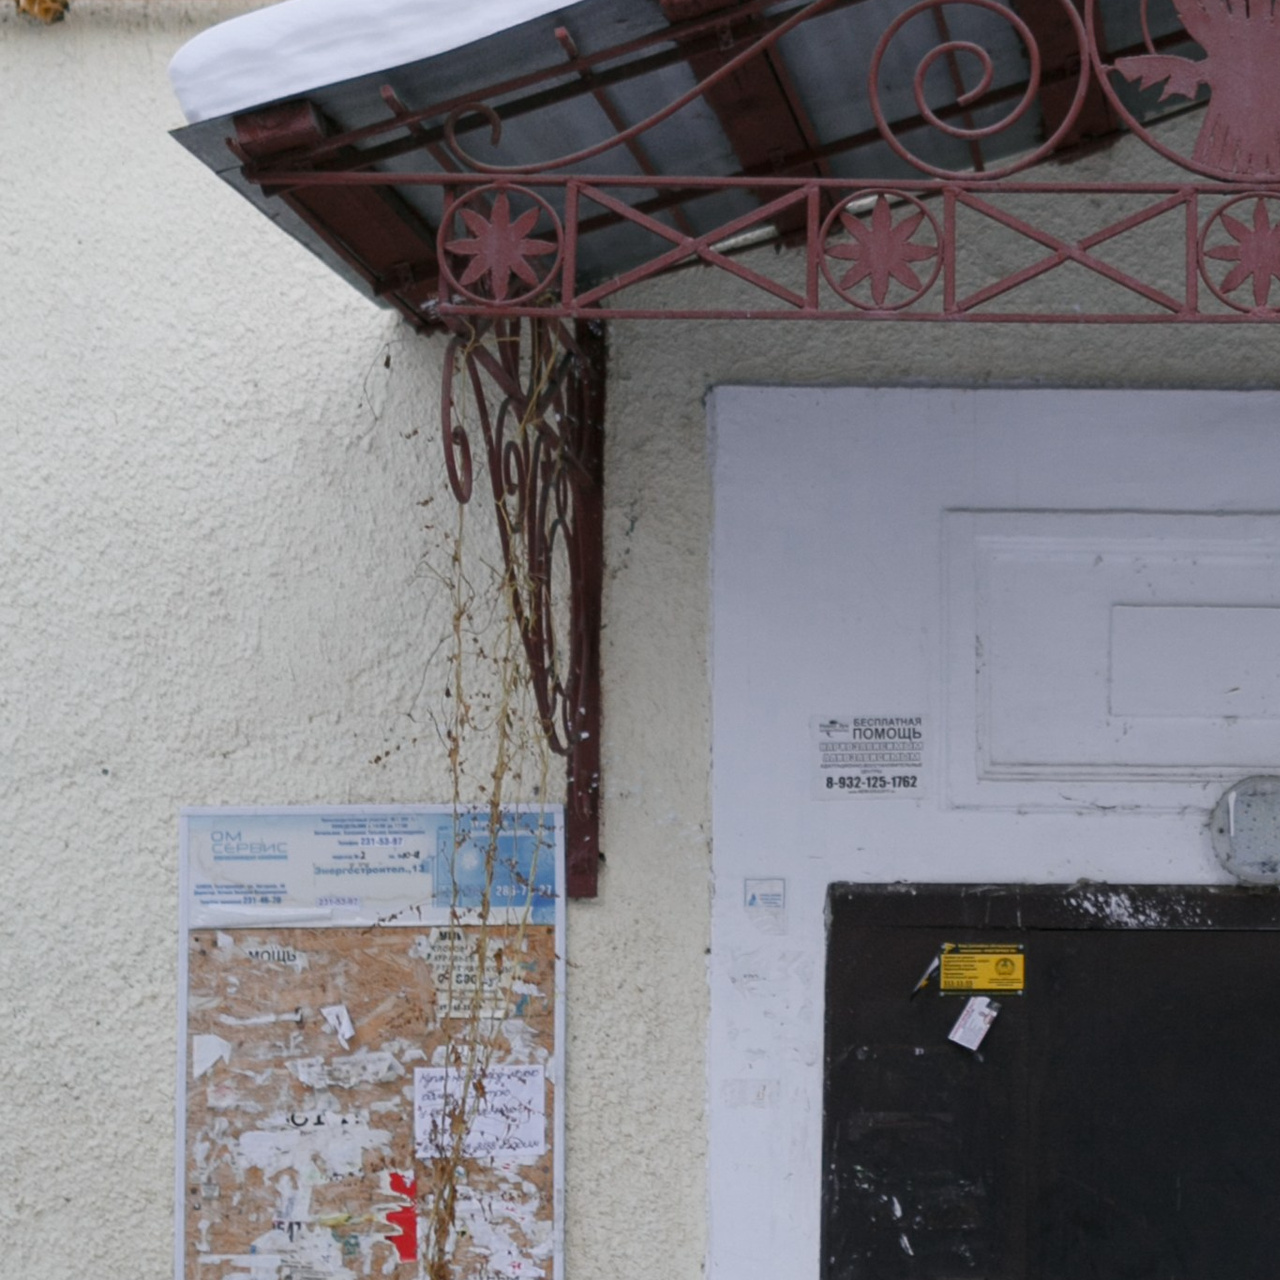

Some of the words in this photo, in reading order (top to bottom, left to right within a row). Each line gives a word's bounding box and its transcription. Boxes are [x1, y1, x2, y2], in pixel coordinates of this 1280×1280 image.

[853, 718, 922, 727] БЕСПЛАТНАЯ
[852, 727, 922, 741] ПОМОЩЬ
[826, 776, 917, 789] 8-932-125-1762
[211, 831, 242, 841] ОМ
[211, 842, 288, 854] СЕРВИС
